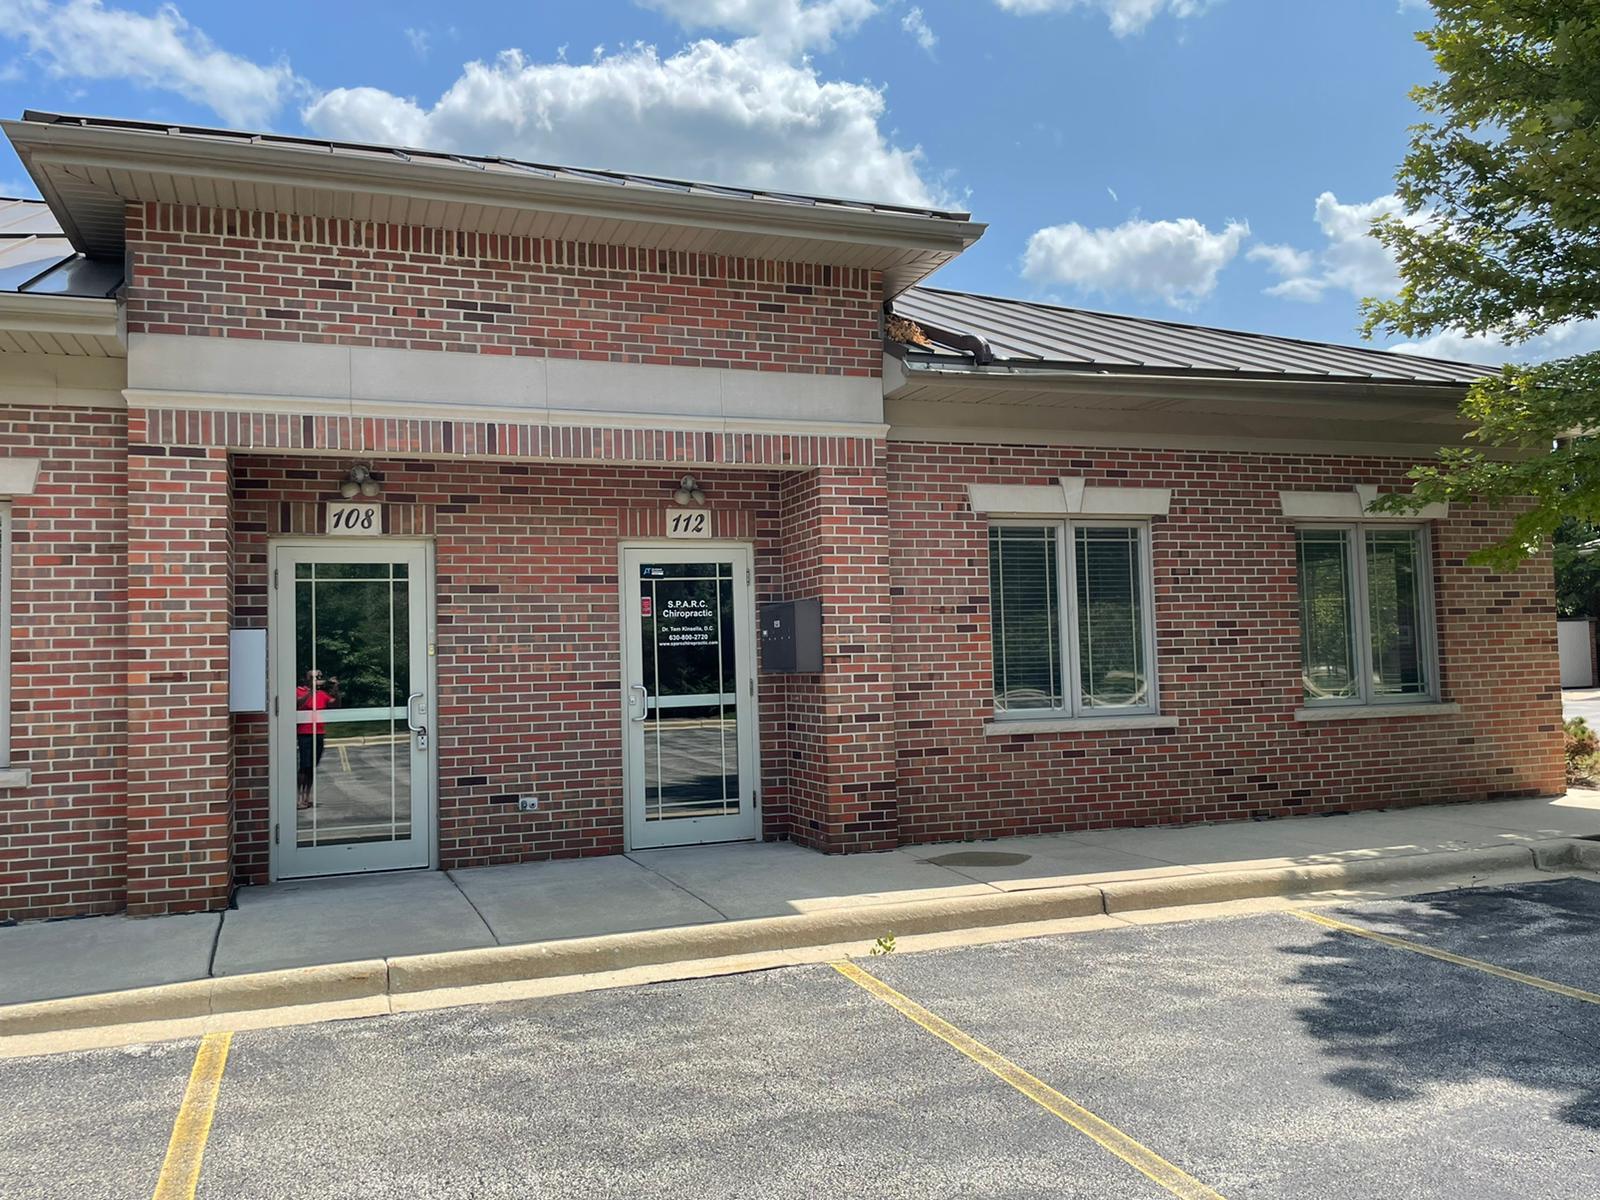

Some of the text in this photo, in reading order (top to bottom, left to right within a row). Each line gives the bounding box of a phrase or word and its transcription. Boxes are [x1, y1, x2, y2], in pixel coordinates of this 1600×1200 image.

[333, 508, 374, 529] 108
[672, 514, 705, 532] 112
[667, 600, 709, 608] S.P.A.R.C.
[662, 609, 713, 618] Chiropractic
